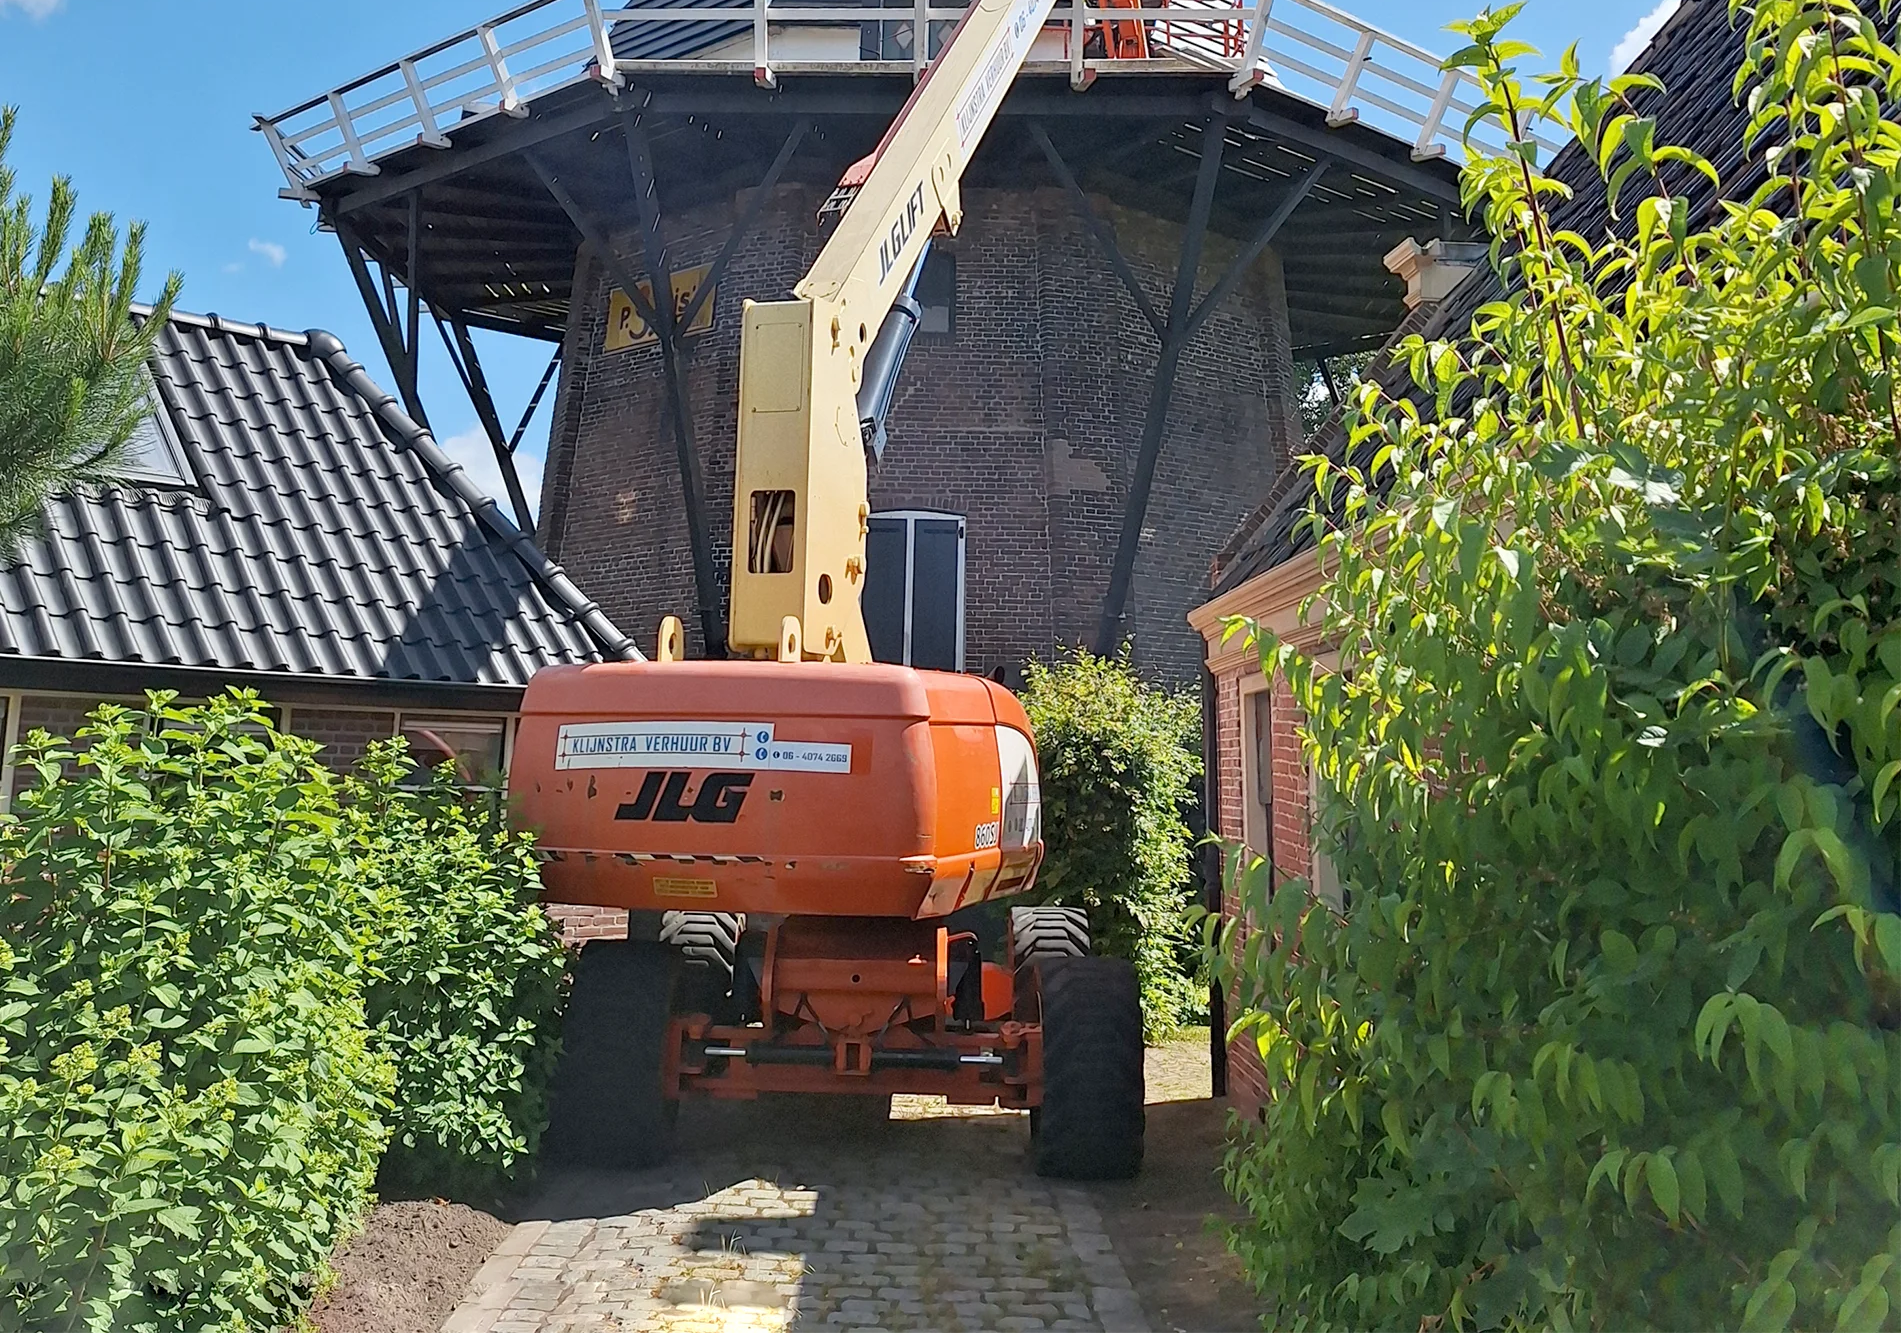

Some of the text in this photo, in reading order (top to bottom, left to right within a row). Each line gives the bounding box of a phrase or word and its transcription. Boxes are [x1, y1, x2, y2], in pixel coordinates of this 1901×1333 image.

[572, 735, 731, 754] KLIJNSTRA VERHUUR BV
[782, 751, 794, 761] 06
[801, 752, 823, 762] 4074
[825, 753, 848, 764] 2669
[614, 771, 755, 823] JLG
